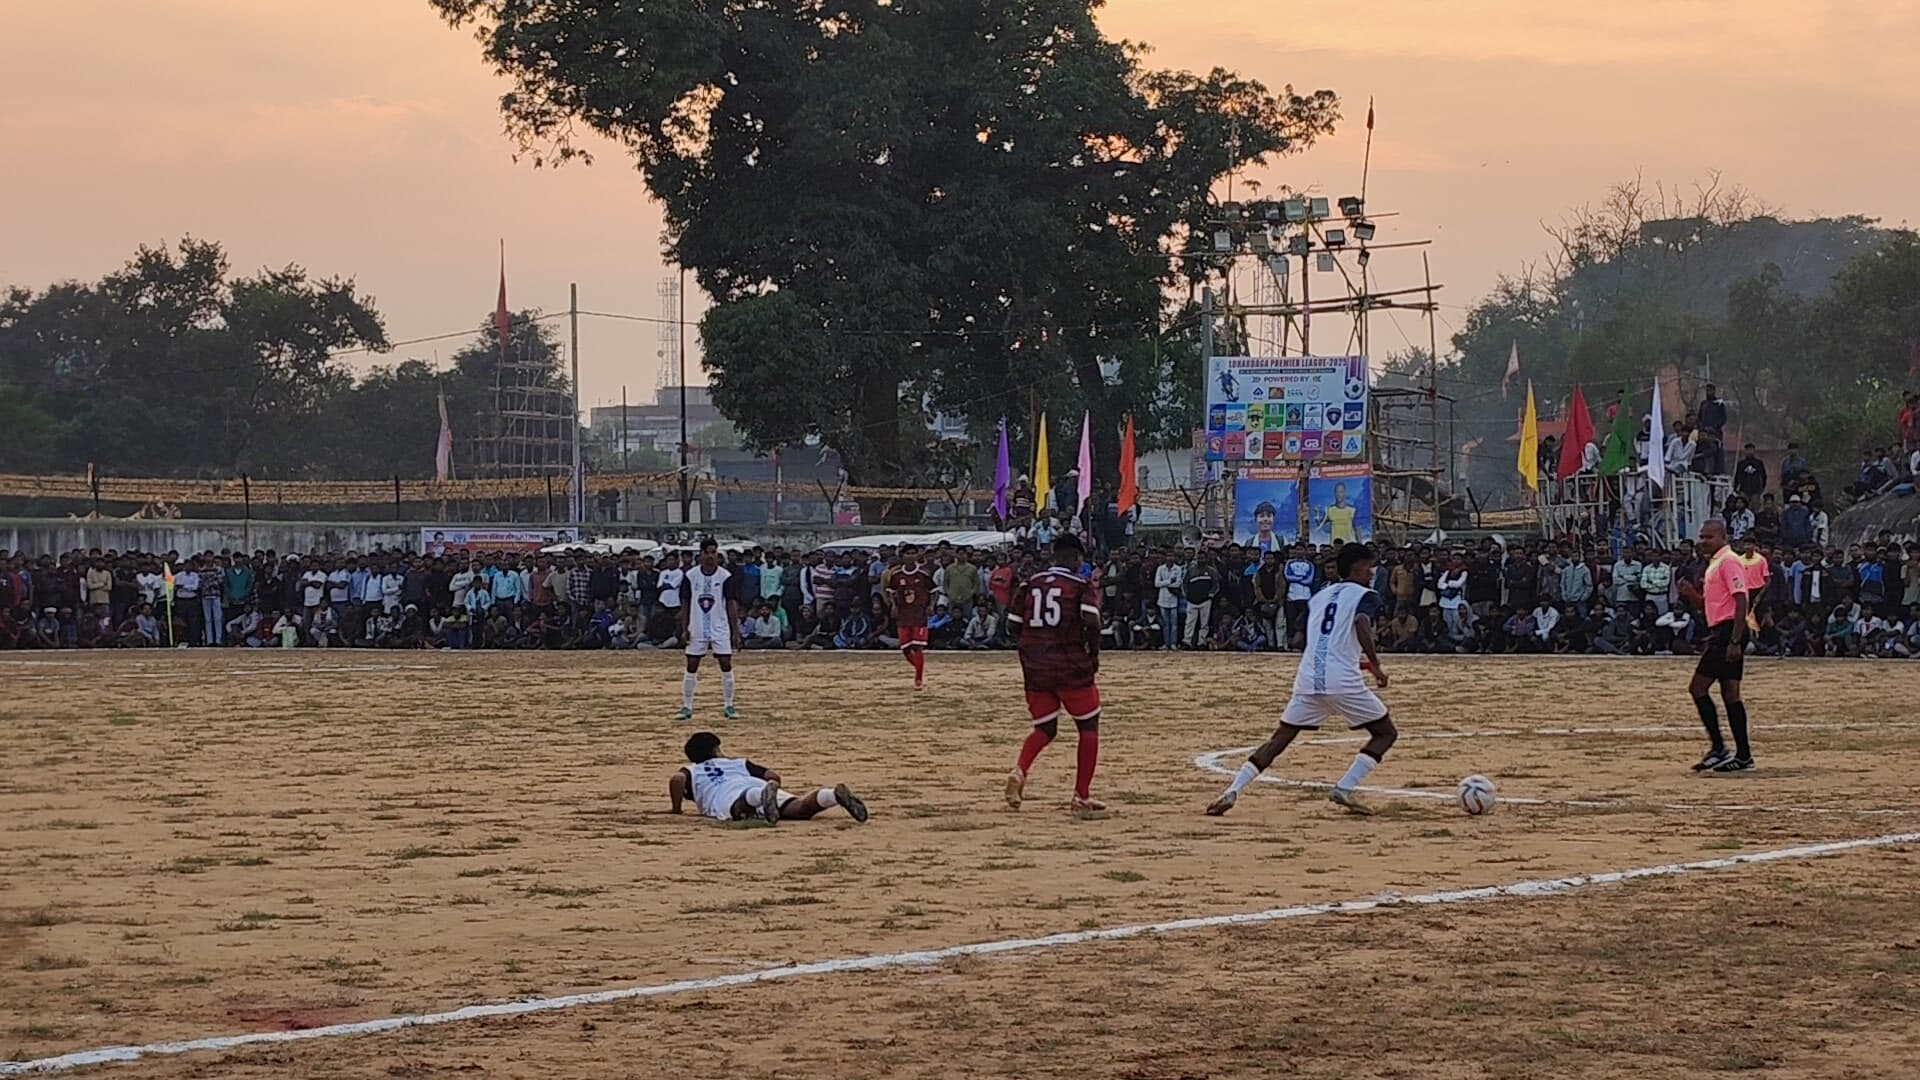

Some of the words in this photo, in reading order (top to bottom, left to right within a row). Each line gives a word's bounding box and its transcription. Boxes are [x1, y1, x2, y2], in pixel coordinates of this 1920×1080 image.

[1270, 359, 1300, 368] PREMIER
[1263, 375, 1301, 383] POWERED
[1301, 375, 1310, 383] BY
[1029, 587, 1062, 628] 15
[1321, 602, 1337, 635] 8
